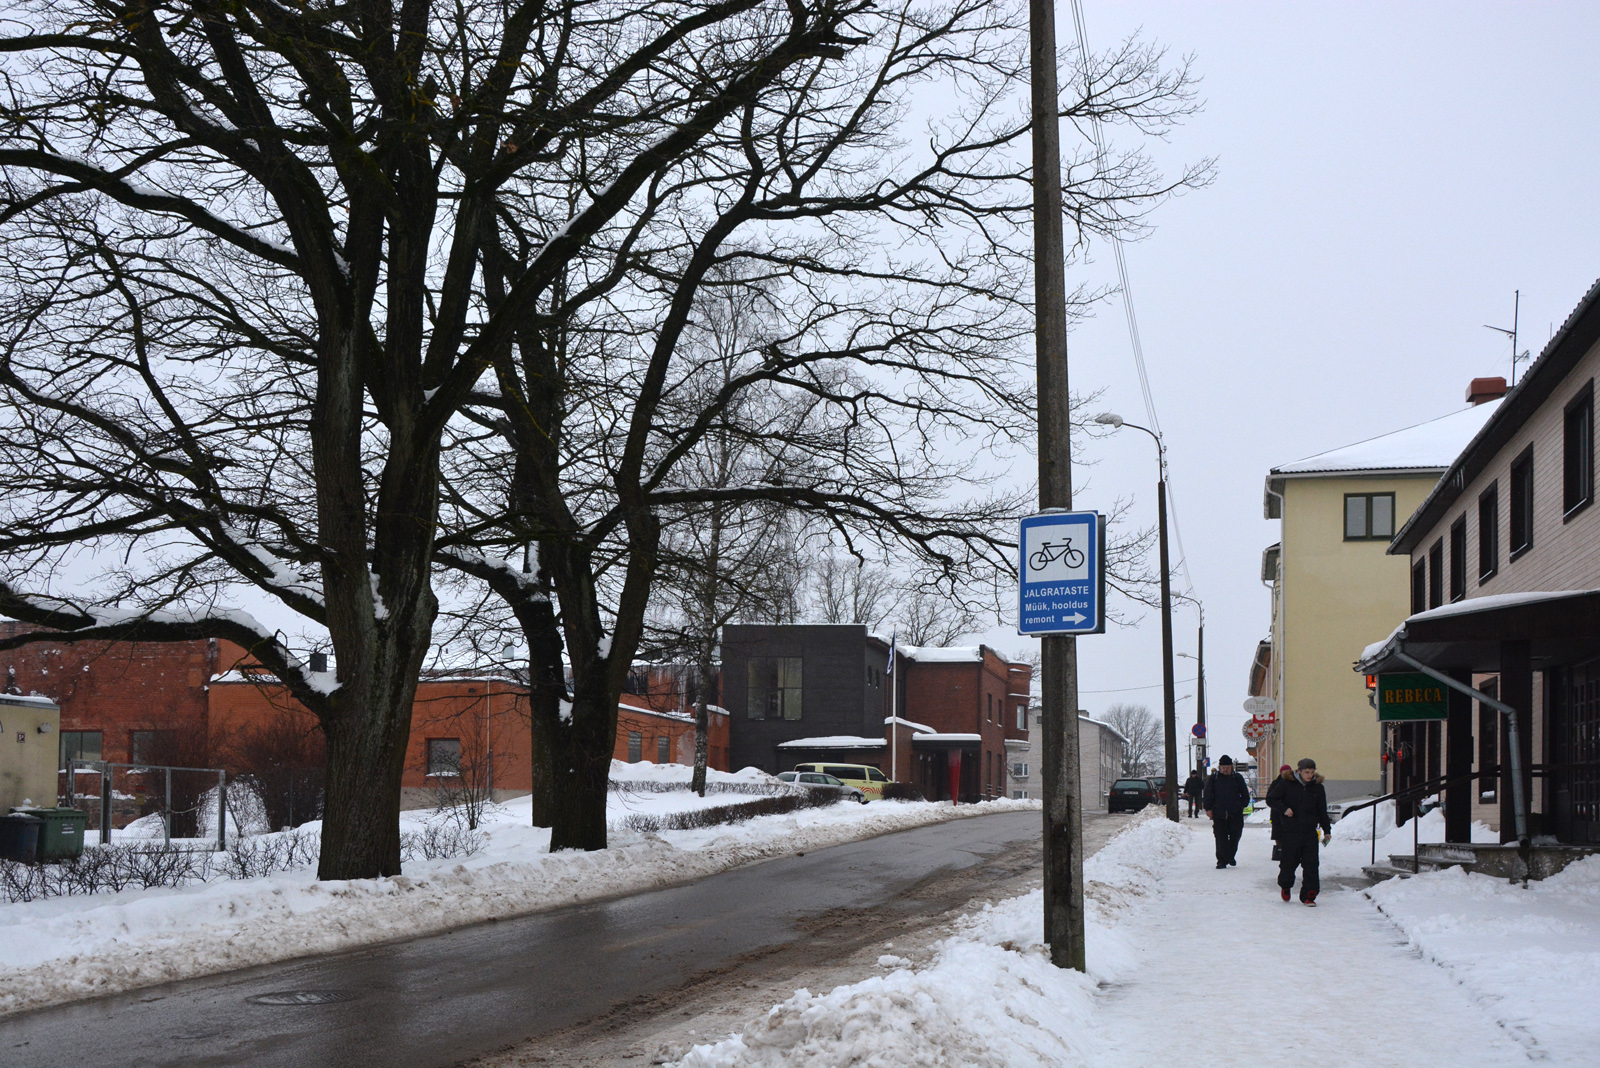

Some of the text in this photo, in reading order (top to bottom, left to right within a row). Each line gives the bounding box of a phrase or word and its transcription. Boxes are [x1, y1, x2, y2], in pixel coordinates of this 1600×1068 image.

[1024, 585, 1089, 598] JALGRATASTE
[1025, 600, 1089, 611] Müük, hooldus
[1025, 615, 1055, 624] remont
[1384, 688, 1442, 704] REBECA
